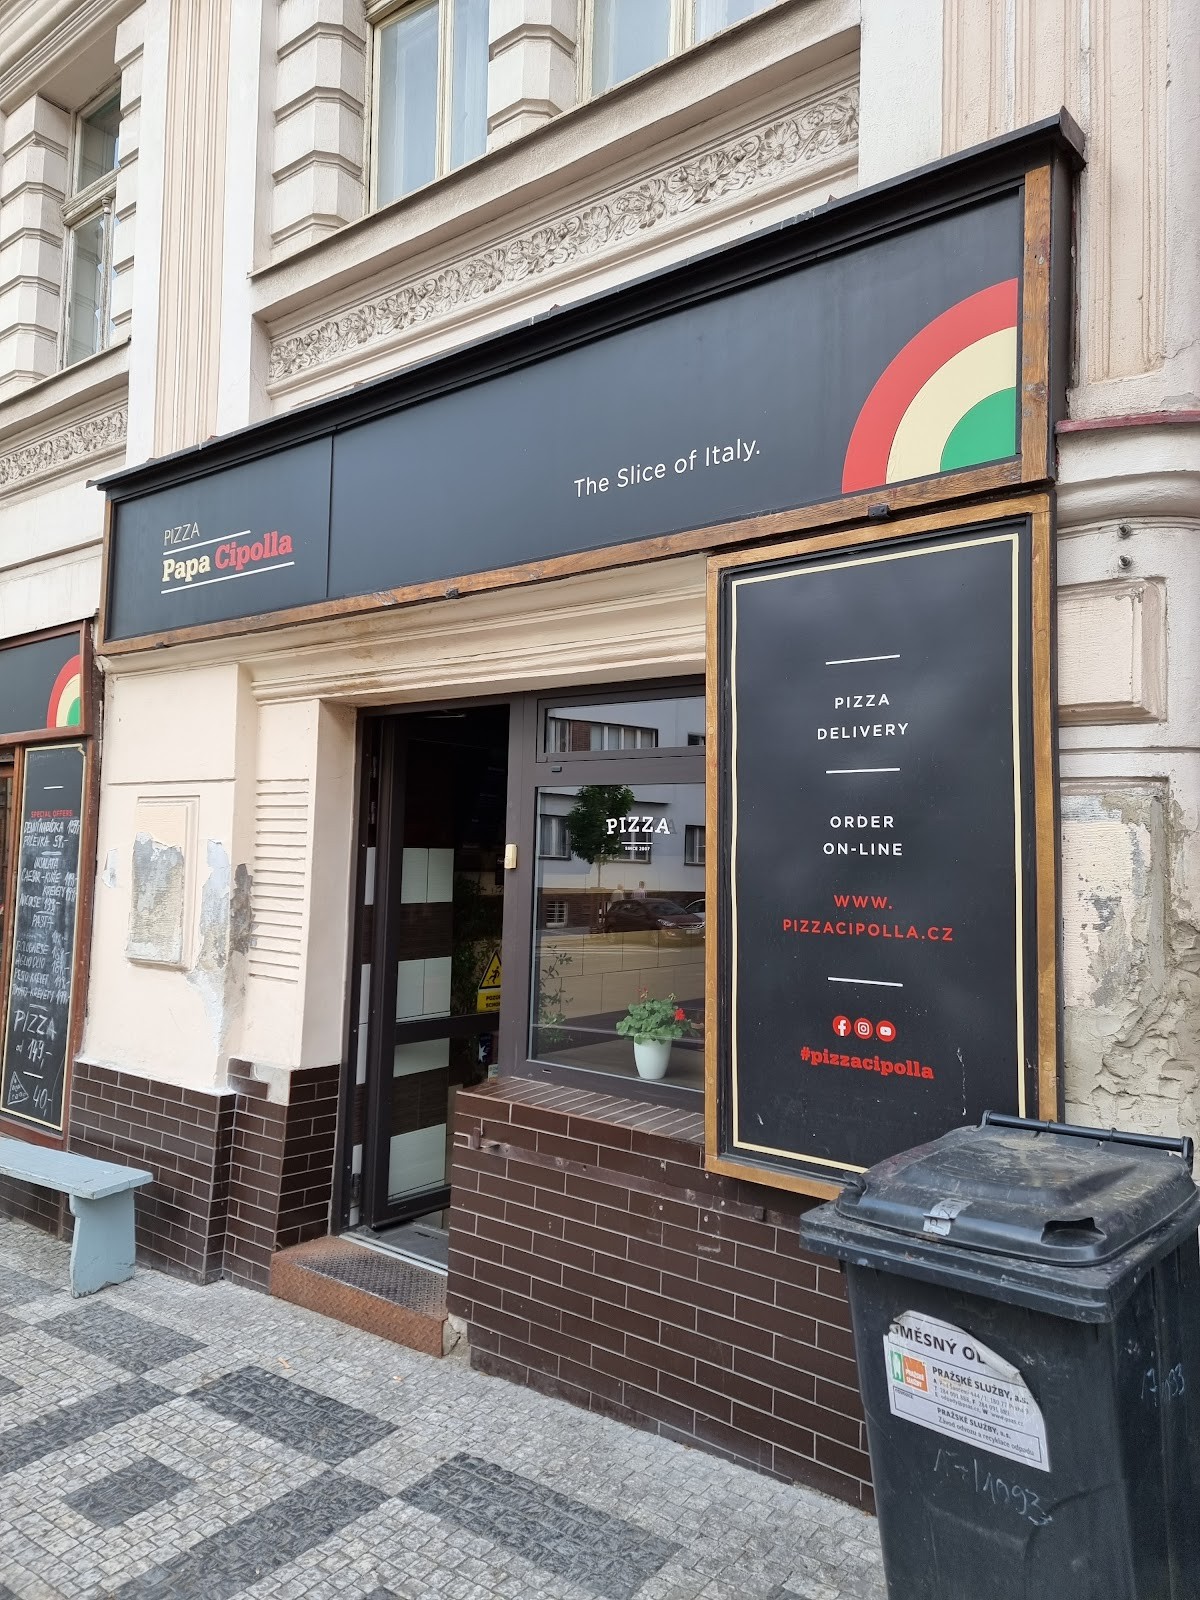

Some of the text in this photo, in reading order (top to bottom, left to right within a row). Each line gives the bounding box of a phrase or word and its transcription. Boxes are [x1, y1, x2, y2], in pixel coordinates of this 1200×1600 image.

[574, 438, 760, 498] The Slice of Italy.
[164, 521, 200, 546] PIZZA
[162, 530, 293, 582] Papa Cipolla
[834, 693, 890, 710] PIZZA
[817, 722, 909, 740] DELIVERY
[31, 810, 74, 819] SPECIAL OFFERS
[829, 815, 895, 828] ORDER
[605, 816, 671, 835] PIZZA
[823, 842, 903, 857] ON-LINE
[833, 894, 893, 910] WWW.
[782, 918, 953, 941] PIZZACIPOLLA.CZ
[14, 1009, 57, 1041] PIZZA
[800, 1046, 934, 1080] #pizzacipolla
[932, 1366, 973, 1387] PRAŽSKÉ
[974, 1380, 1013, 1401] SLUŽBY,
[937, 1407, 968, 1424] PRAŽSKÉ
